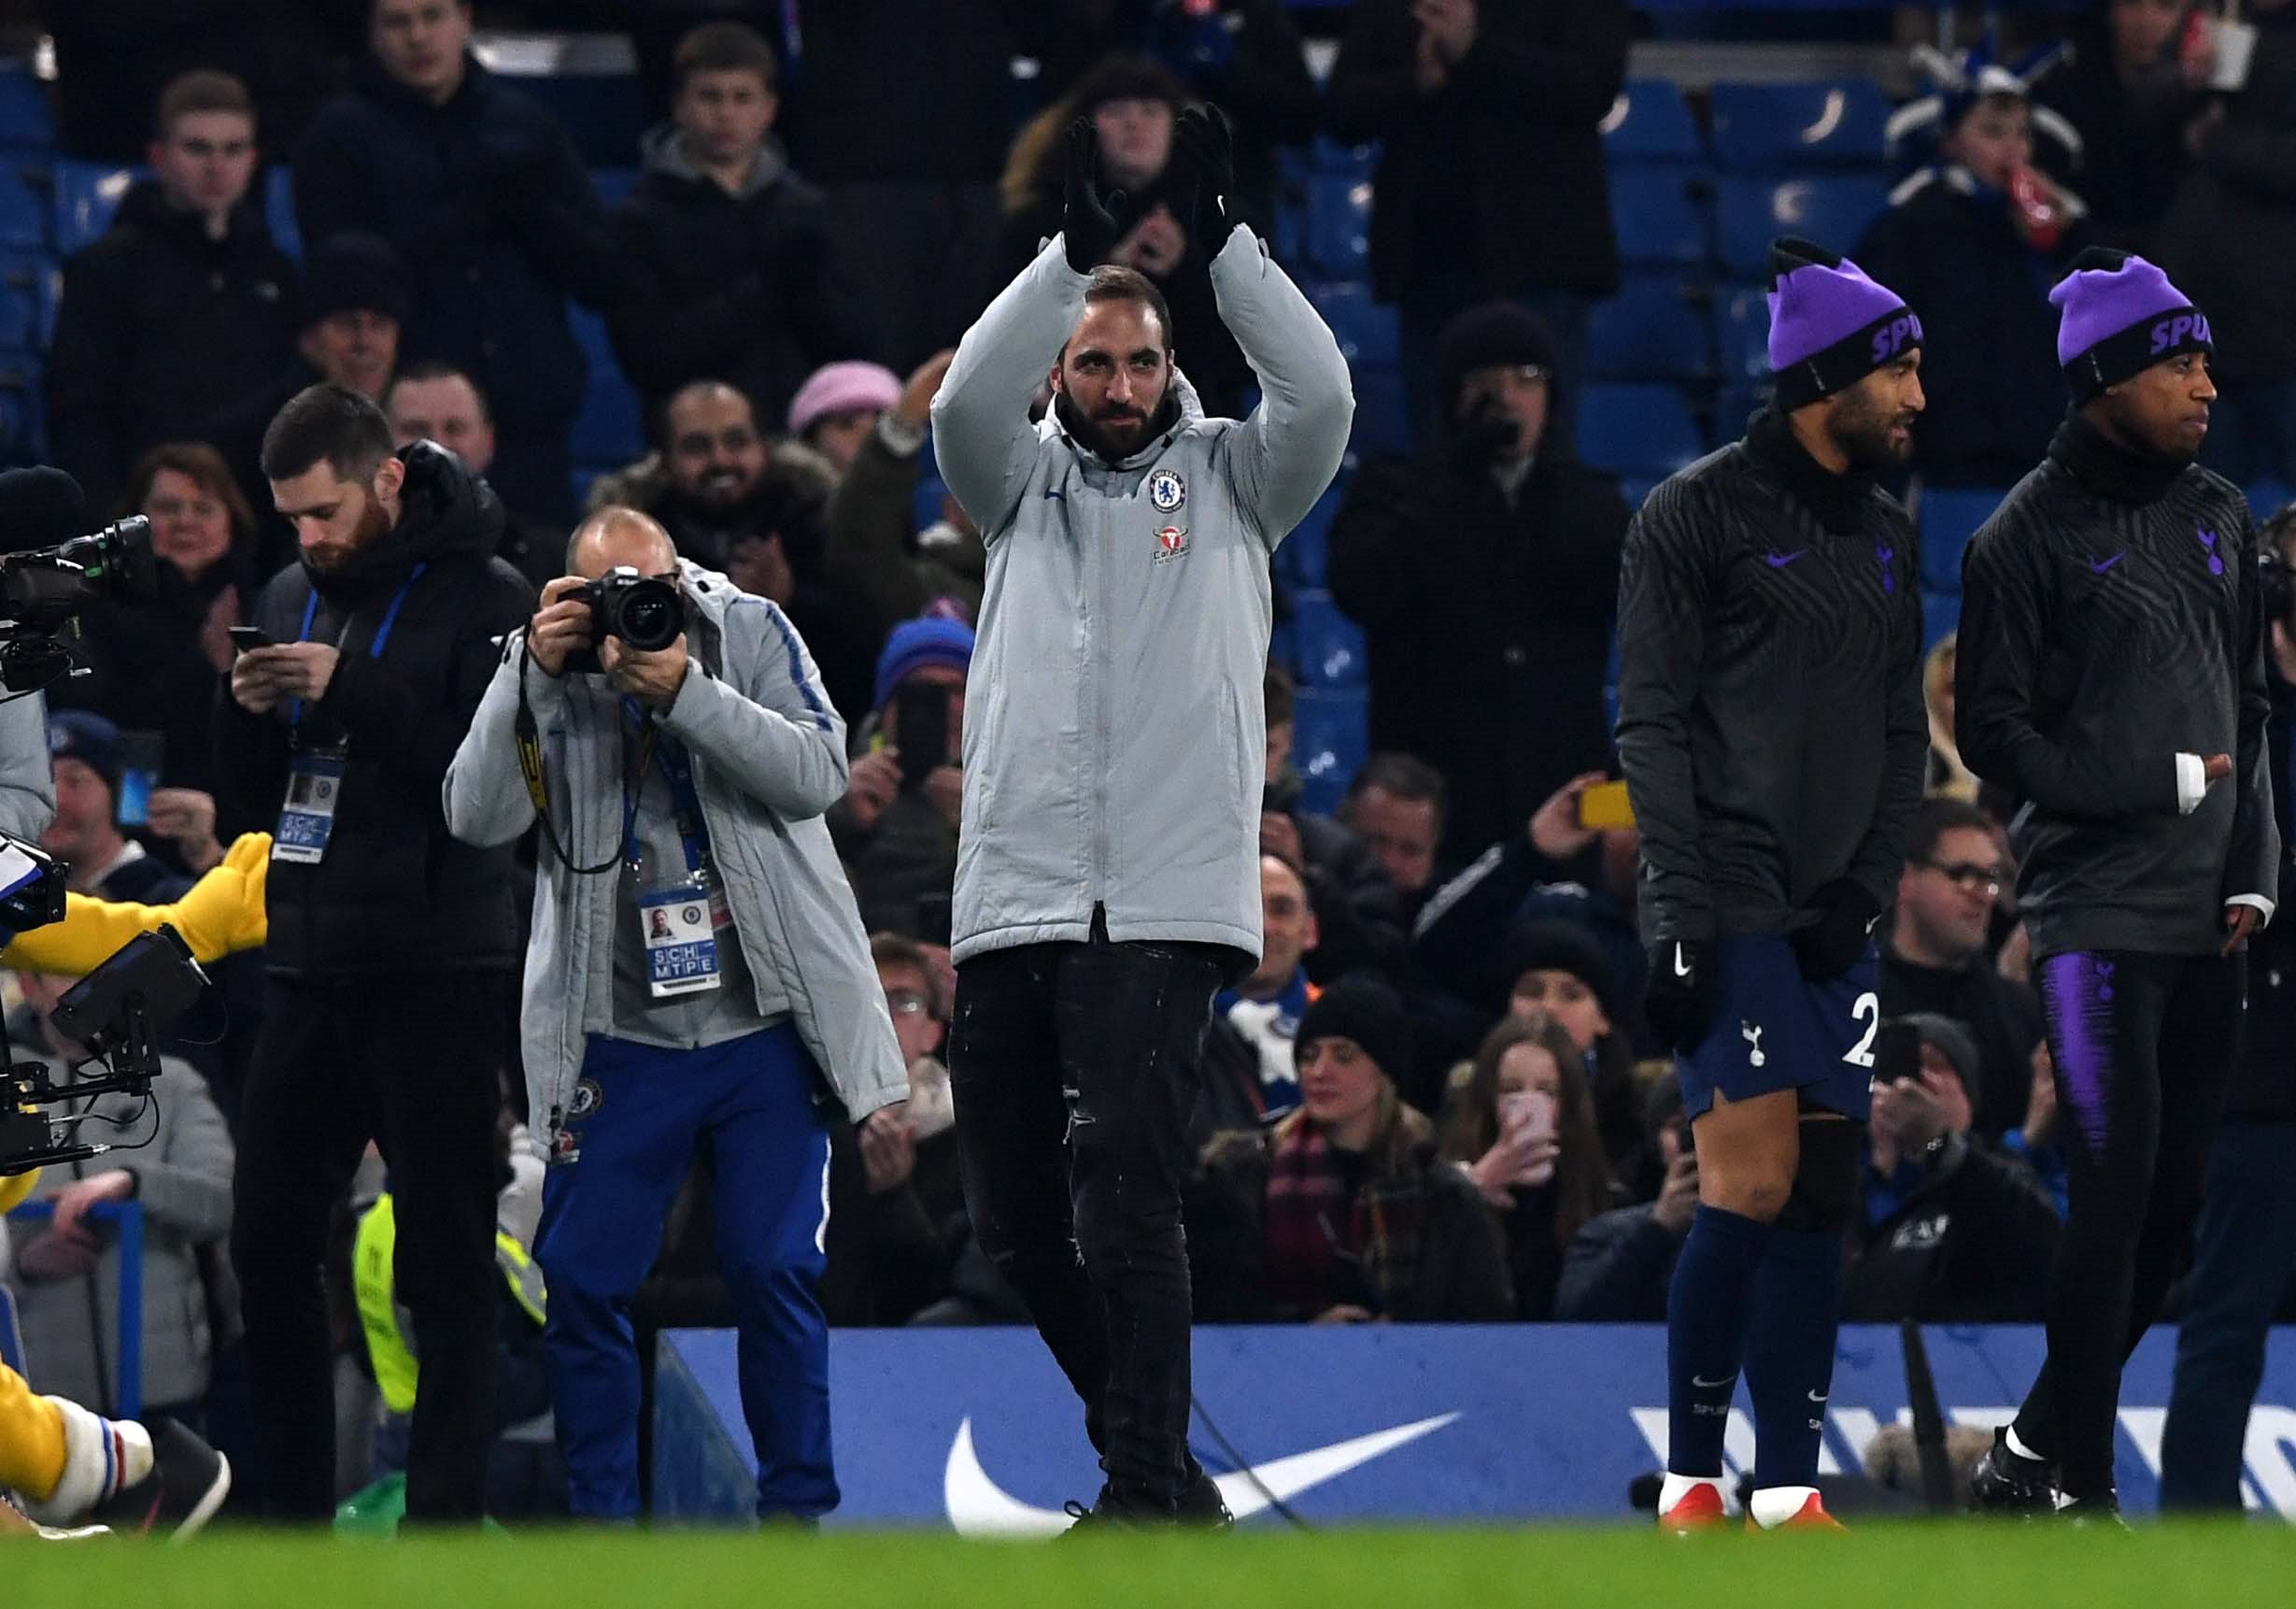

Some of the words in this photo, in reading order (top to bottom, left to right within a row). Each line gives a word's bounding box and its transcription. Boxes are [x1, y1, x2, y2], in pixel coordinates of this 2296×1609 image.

[2151, 313, 2212, 356] SPU
[655, 946, 696, 963] SCH
[656, 959, 712, 978] MTPE
